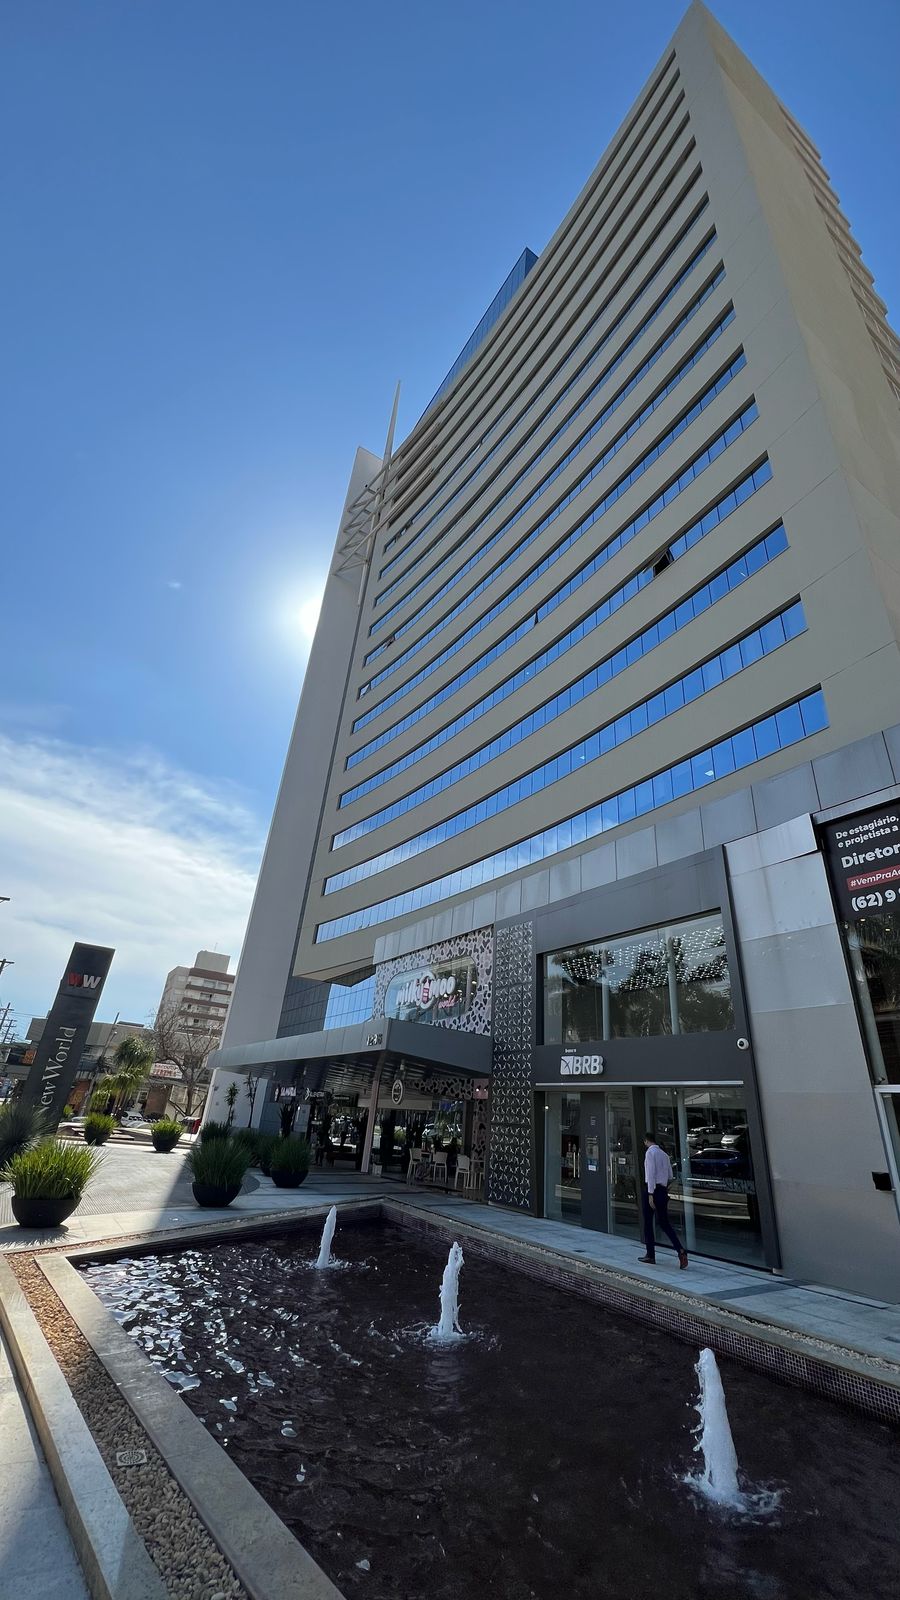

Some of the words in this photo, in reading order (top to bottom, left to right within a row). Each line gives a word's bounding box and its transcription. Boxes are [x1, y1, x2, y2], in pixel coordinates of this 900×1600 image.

[836, 831, 848, 839] De
[849, 815, 899, 835] estagiário,
[845, 827, 891, 848] projetista
[841, 843, 900, 868] Diretor
[851, 891, 883, 912] (62)
[42, 1026, 77, 1081] World
[573, 1055, 604, 1075] BRB
